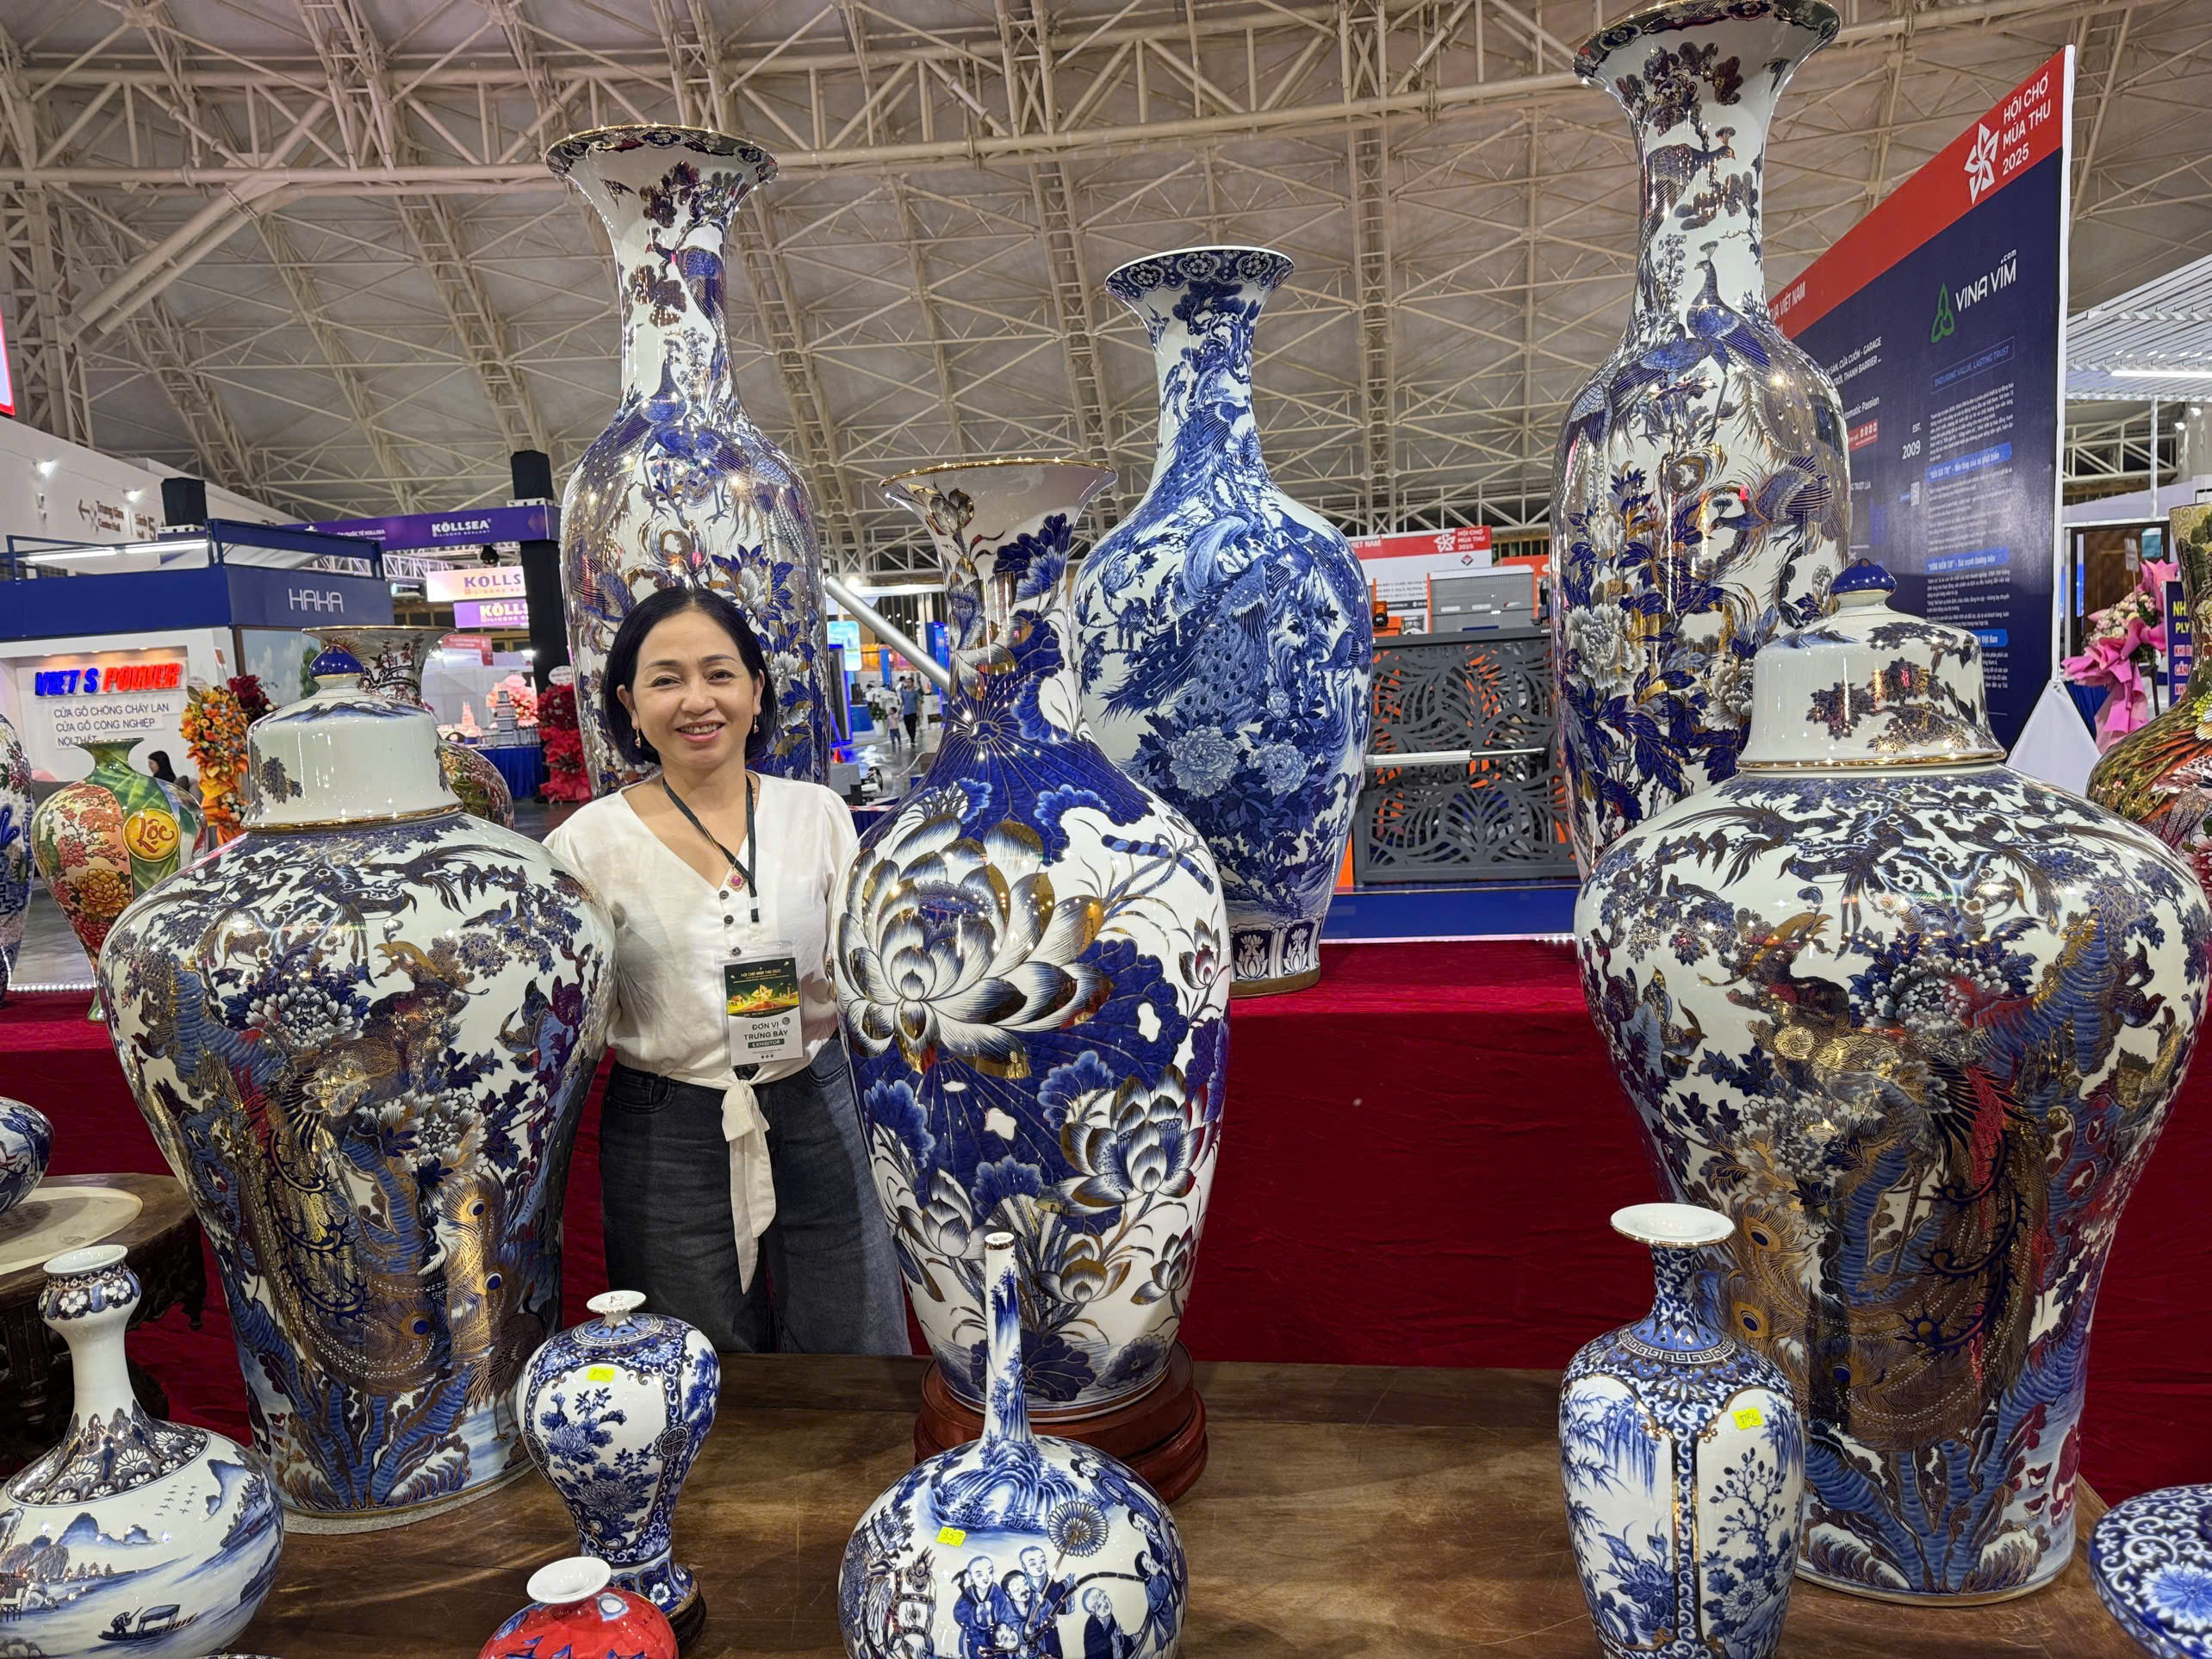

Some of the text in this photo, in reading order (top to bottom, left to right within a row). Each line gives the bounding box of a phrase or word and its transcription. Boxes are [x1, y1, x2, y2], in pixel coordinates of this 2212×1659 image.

[2004, 71, 2048, 125] HỘI CHỢ
[2003, 99, 2051, 151] MÙA THU
[2002, 142, 2029, 176] 2025
[1793, 281, 1805, 307] NAM
[1861, 396, 1880, 412] Passion
[1902, 439, 1921, 460] 2009
[432, 519, 489, 532] KÖLLSEA
[1364, 539, 1382, 548] NAM
[463, 573, 521, 587] KÖLLS
[2172, 600, 2187, 617] NH
[103, 662, 183, 693] POWER
[54, 701, 170, 718] CỬA GỖ CHỐNG CHÁY LAN
[56, 718, 156, 732] CỬA GỖ CÔNG NGHIỆP
[137, 817, 175, 854] Lộc
[772, 1021, 780, 1029] VỊ
[744, 1028, 788, 1041] TRƯNG BÀY
